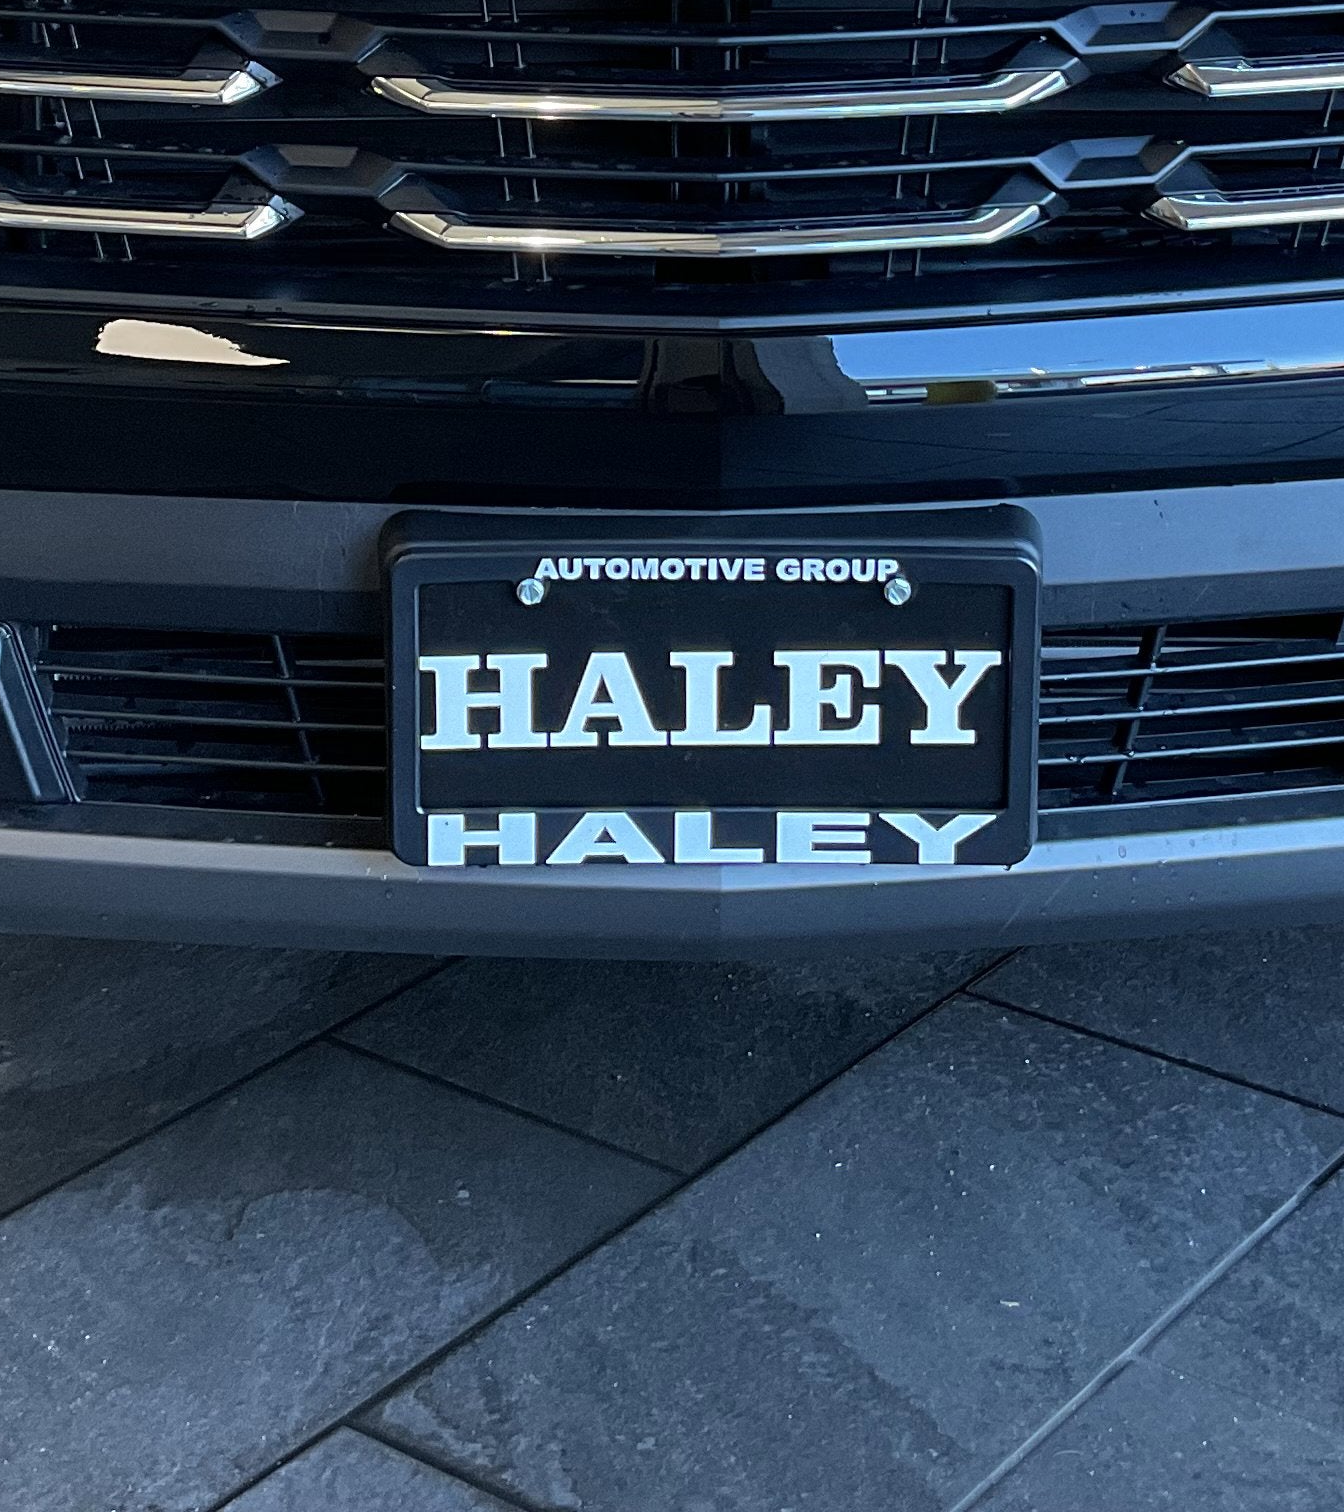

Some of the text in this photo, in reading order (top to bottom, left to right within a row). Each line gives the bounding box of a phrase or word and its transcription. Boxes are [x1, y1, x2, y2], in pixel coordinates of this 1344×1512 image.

[534, 556, 899, 583] AUTOMOTIVE GROUP
[418, 649, 1002, 749] HALEY
[426, 810, 997, 866] HALEY
